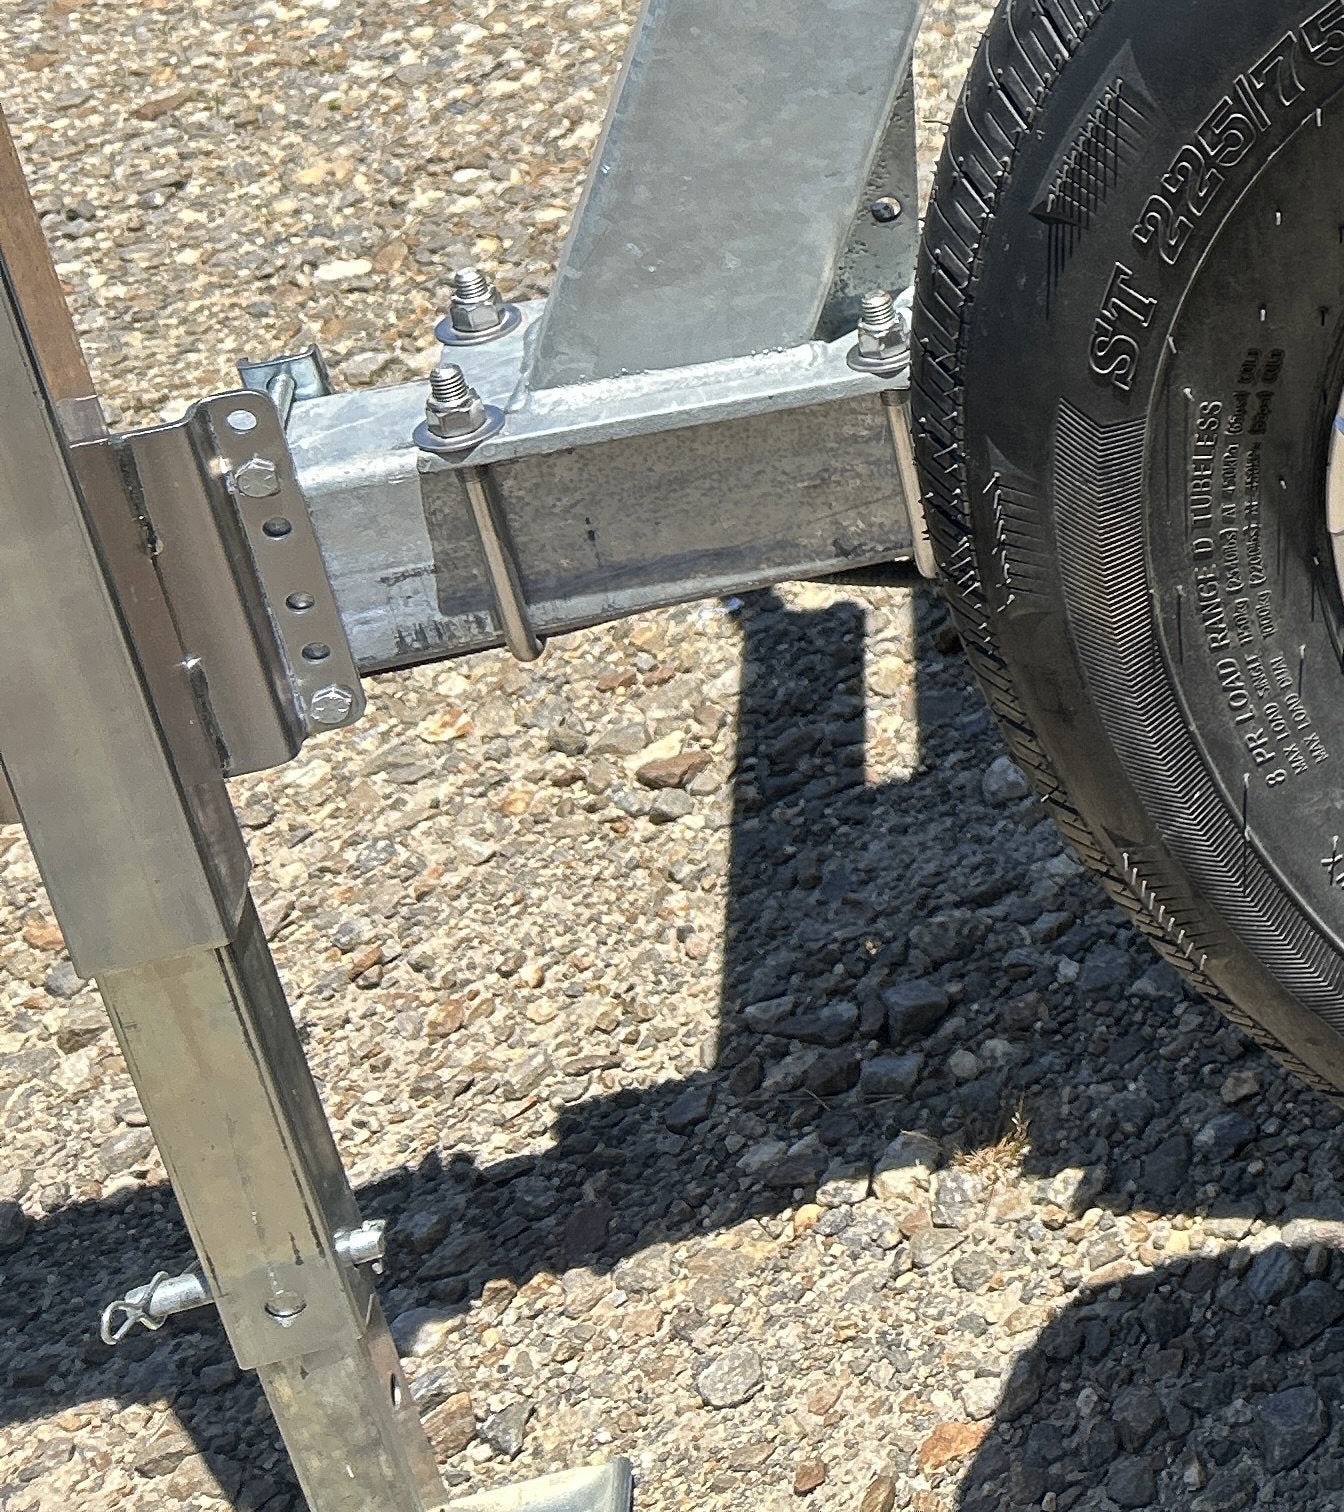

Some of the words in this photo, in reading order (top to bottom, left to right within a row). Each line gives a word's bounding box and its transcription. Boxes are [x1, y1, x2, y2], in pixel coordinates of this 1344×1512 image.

[1088, 261, 1158, 390] ST
[1189, 396, 1224, 523] TUBELESS
[1190, 536, 1216, 553] D
[1192, 562, 1234, 649] RANGE
[1211, 654, 1260, 723] LOAD
[1242, 651, 1275, 696] SINGLE
[1267, 652, 1296, 688] DUAL
[1260, 699, 1294, 740] LOAD
[1281, 690, 1314, 729] LOAD
[1239, 725, 1279, 763] PR
[1280, 742, 1312, 775] MAX
[1300, 731, 1330, 762] MAX
[1261, 766, 1291, 786] 8
